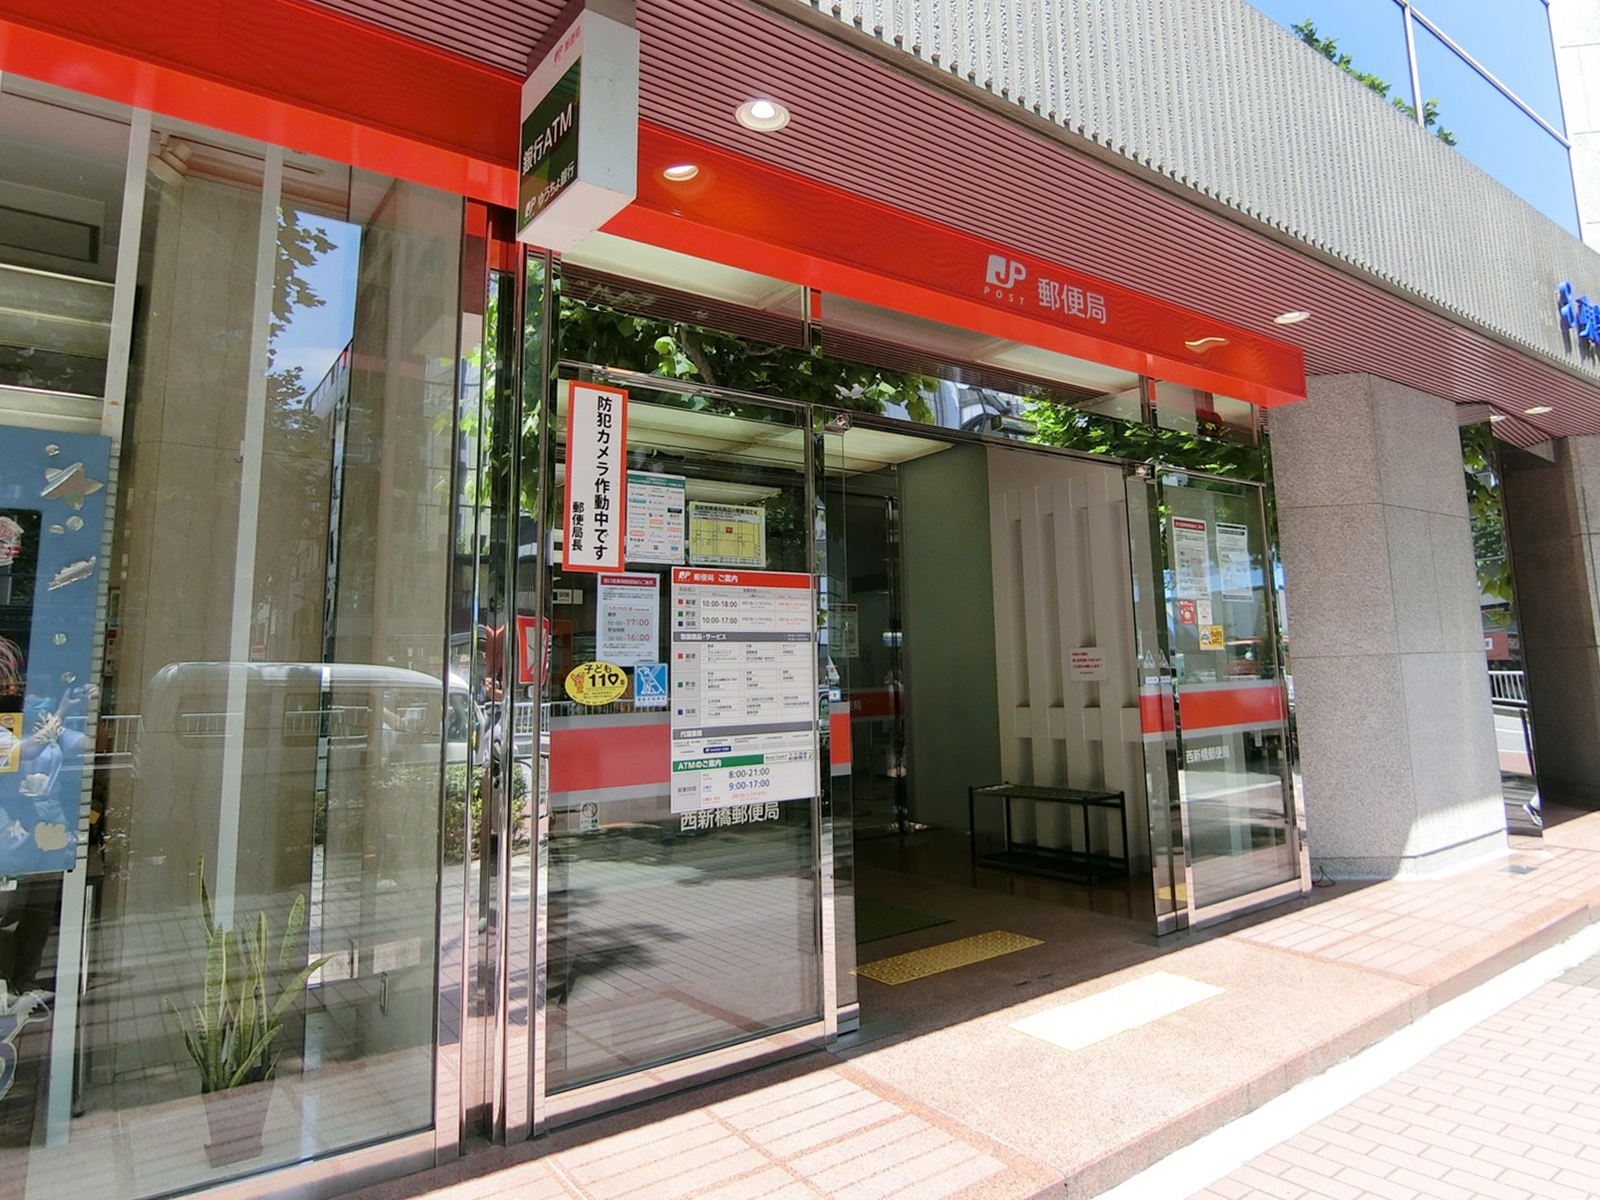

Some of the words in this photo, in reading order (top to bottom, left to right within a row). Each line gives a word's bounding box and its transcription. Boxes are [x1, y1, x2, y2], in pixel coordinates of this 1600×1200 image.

[522, 102, 573, 175] 銀行ATM
[537, 161, 575, 208] ゆうちょ銀行
[983, 286, 1025, 305] POST
[985, 254, 1027, 289] JP
[1038, 277, 1107, 325] 郵便局
[594, 395, 613, 561] 防犯カメラ作動中です
[571, 501, 585, 551] 郵便局長
[693, 573, 714, 582] 郵便局
[718, 574, 738, 583] ご案内
[702, 600, 738, 608] 10:00-18:00
[584, 664, 612, 674] 子ども
[1185, 746, 1230, 764] 西新橋郵便局
[677, 759, 722, 770] ATMのご案内
[728, 767, 770, 779] 8:00-21:00
[728, 779, 770, 791] 9:00-17:00
[680, 802, 780, 831] 西新橋郵便局
